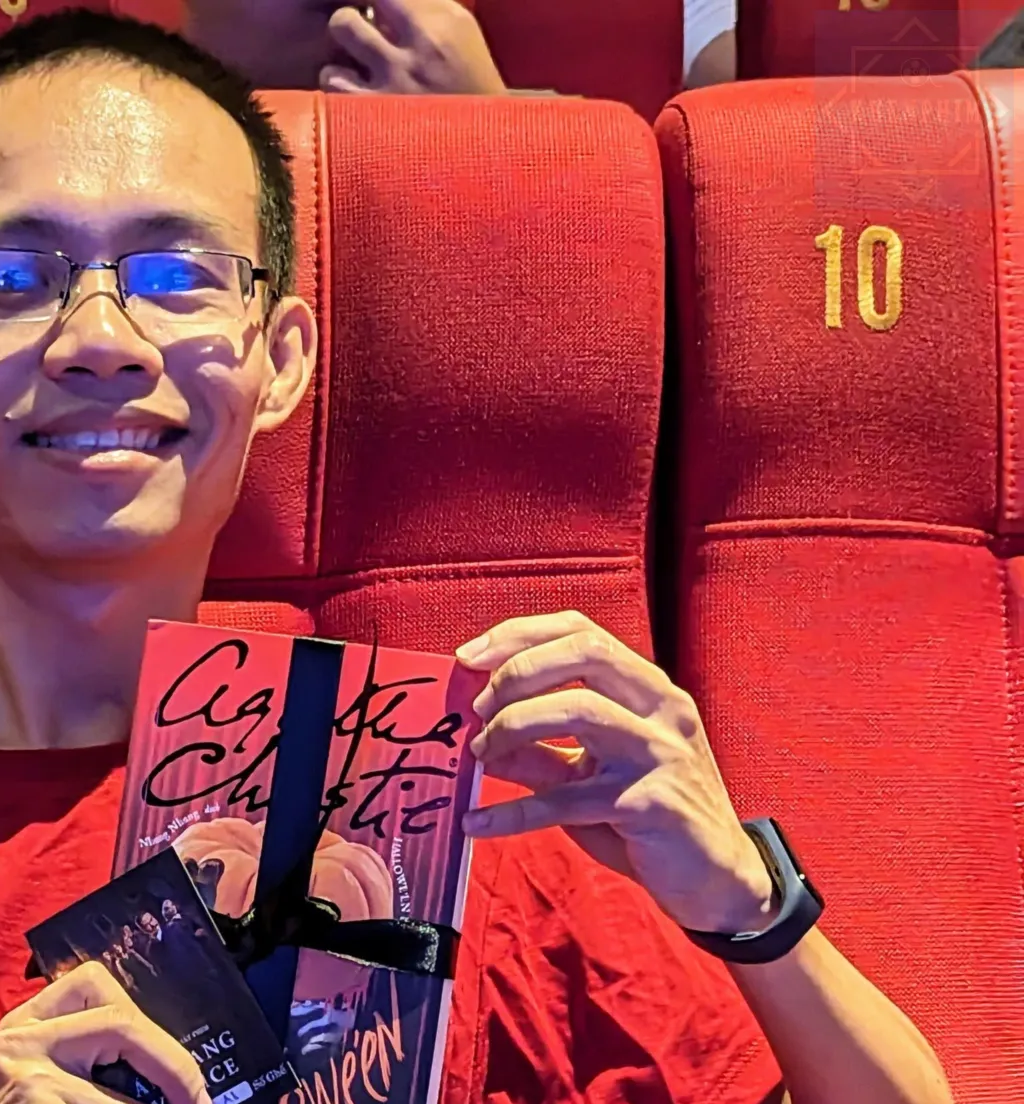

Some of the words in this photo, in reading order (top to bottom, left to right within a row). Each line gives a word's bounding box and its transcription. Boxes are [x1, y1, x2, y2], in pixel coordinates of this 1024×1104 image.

[814, 225, 903, 330] 10
[154, 626, 463, 754] Agtha
[142, 741, 458, 838] Chstie
